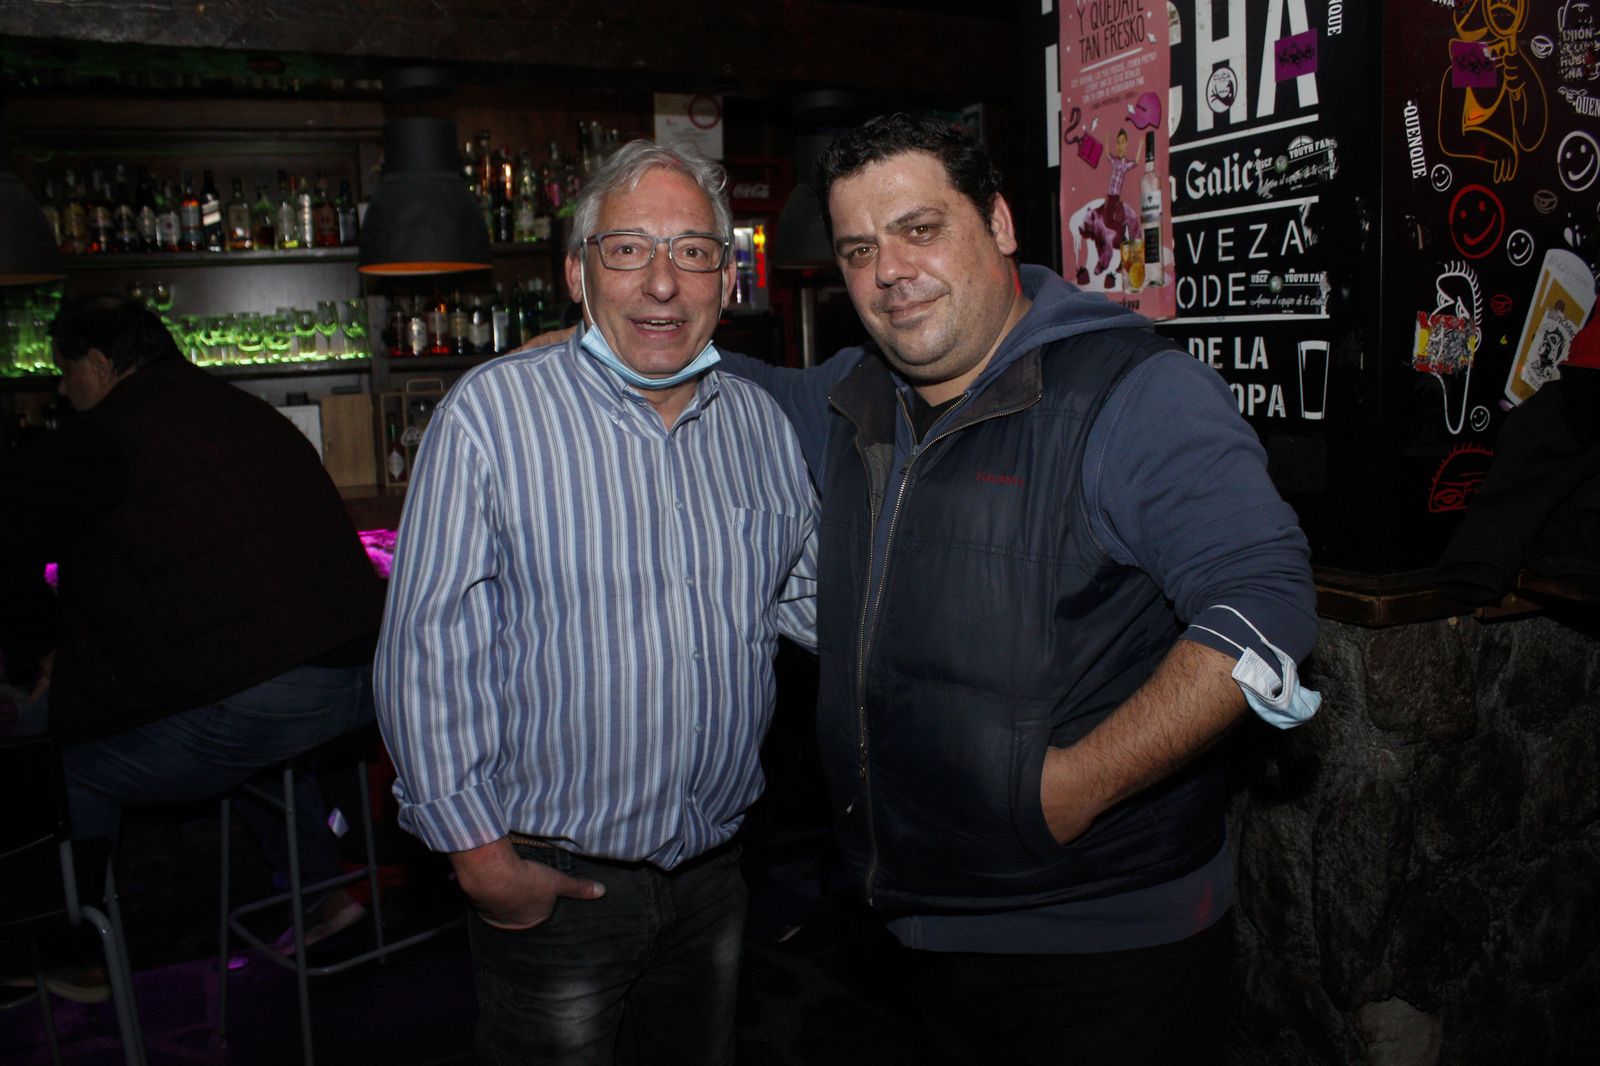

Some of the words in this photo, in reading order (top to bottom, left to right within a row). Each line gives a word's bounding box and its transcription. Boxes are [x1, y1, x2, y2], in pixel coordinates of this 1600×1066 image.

[1077, 6, 1086, 35] Y
[1079, 31, 1100, 64] TAN
[1103, 15, 1144, 55] FRESKO
[1289, 144, 1314, 159] YOUTH
[1403, 104, 1427, 179] QUENQUE
[1186, 147, 1265, 200] Galici
[1284, 273, 1309, 283] YOUTH
[1188, 336, 1224, 369] DE
[1234, 336, 1269, 370] LA
